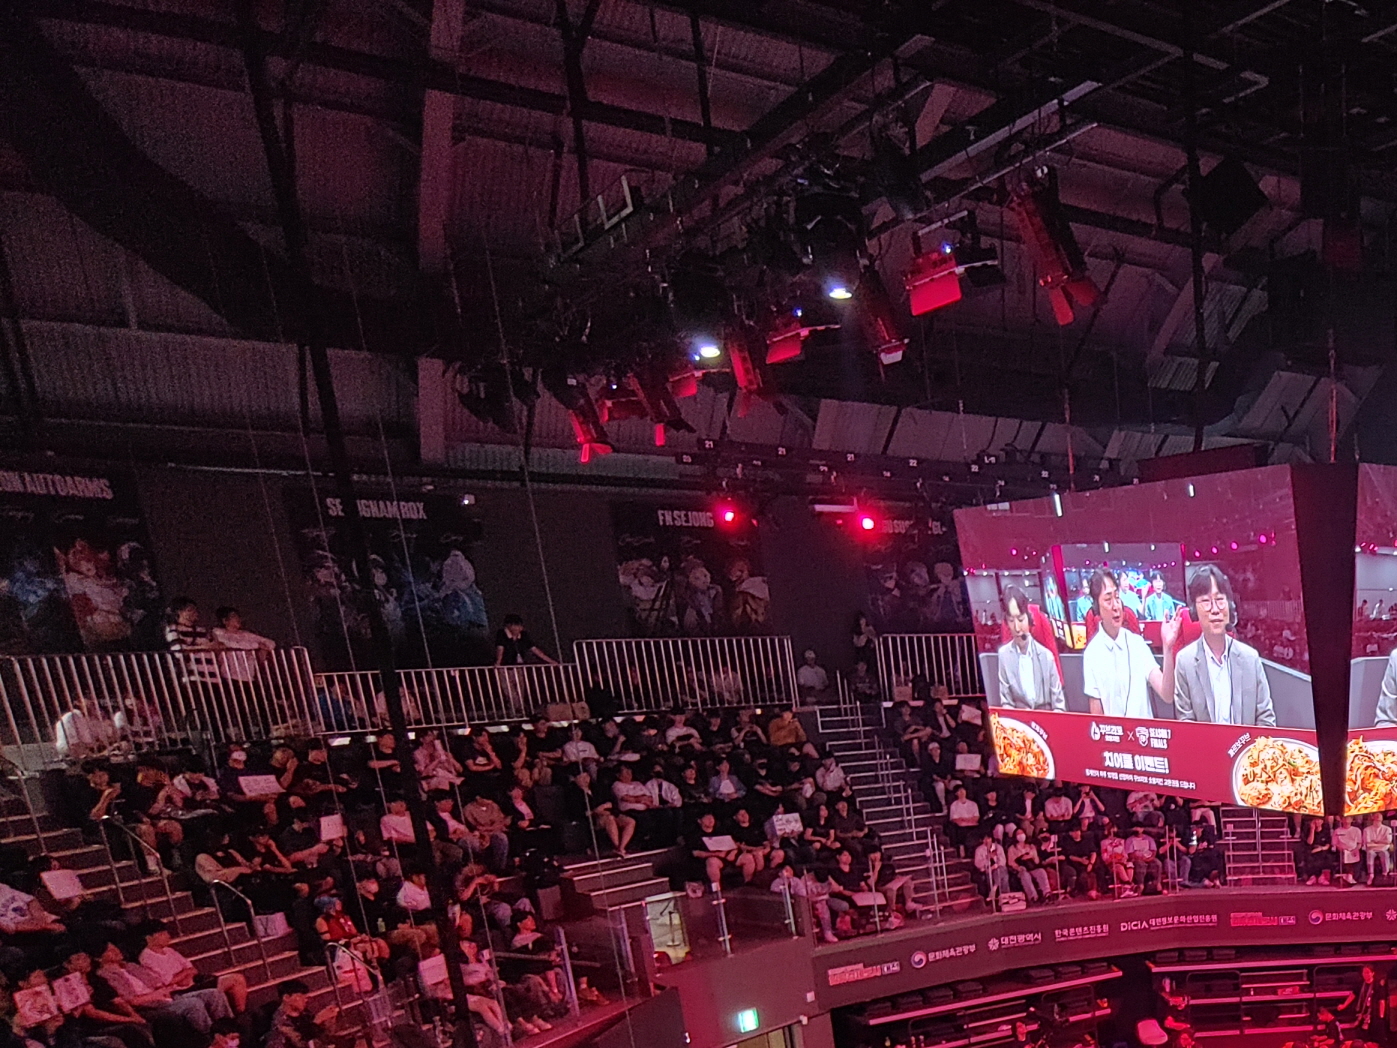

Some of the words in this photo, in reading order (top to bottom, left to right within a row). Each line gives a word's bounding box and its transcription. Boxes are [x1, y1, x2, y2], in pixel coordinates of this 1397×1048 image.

[1103, 751, 1134, 770] 치어풀
[1134, 755, 1170, 774] 이벤트!
[1325, 911, 1373, 921] 문화체육관광부
[1001, 932, 1041, 945] 대전광역시
[928, 944, 976, 962] 문화체육관광부
